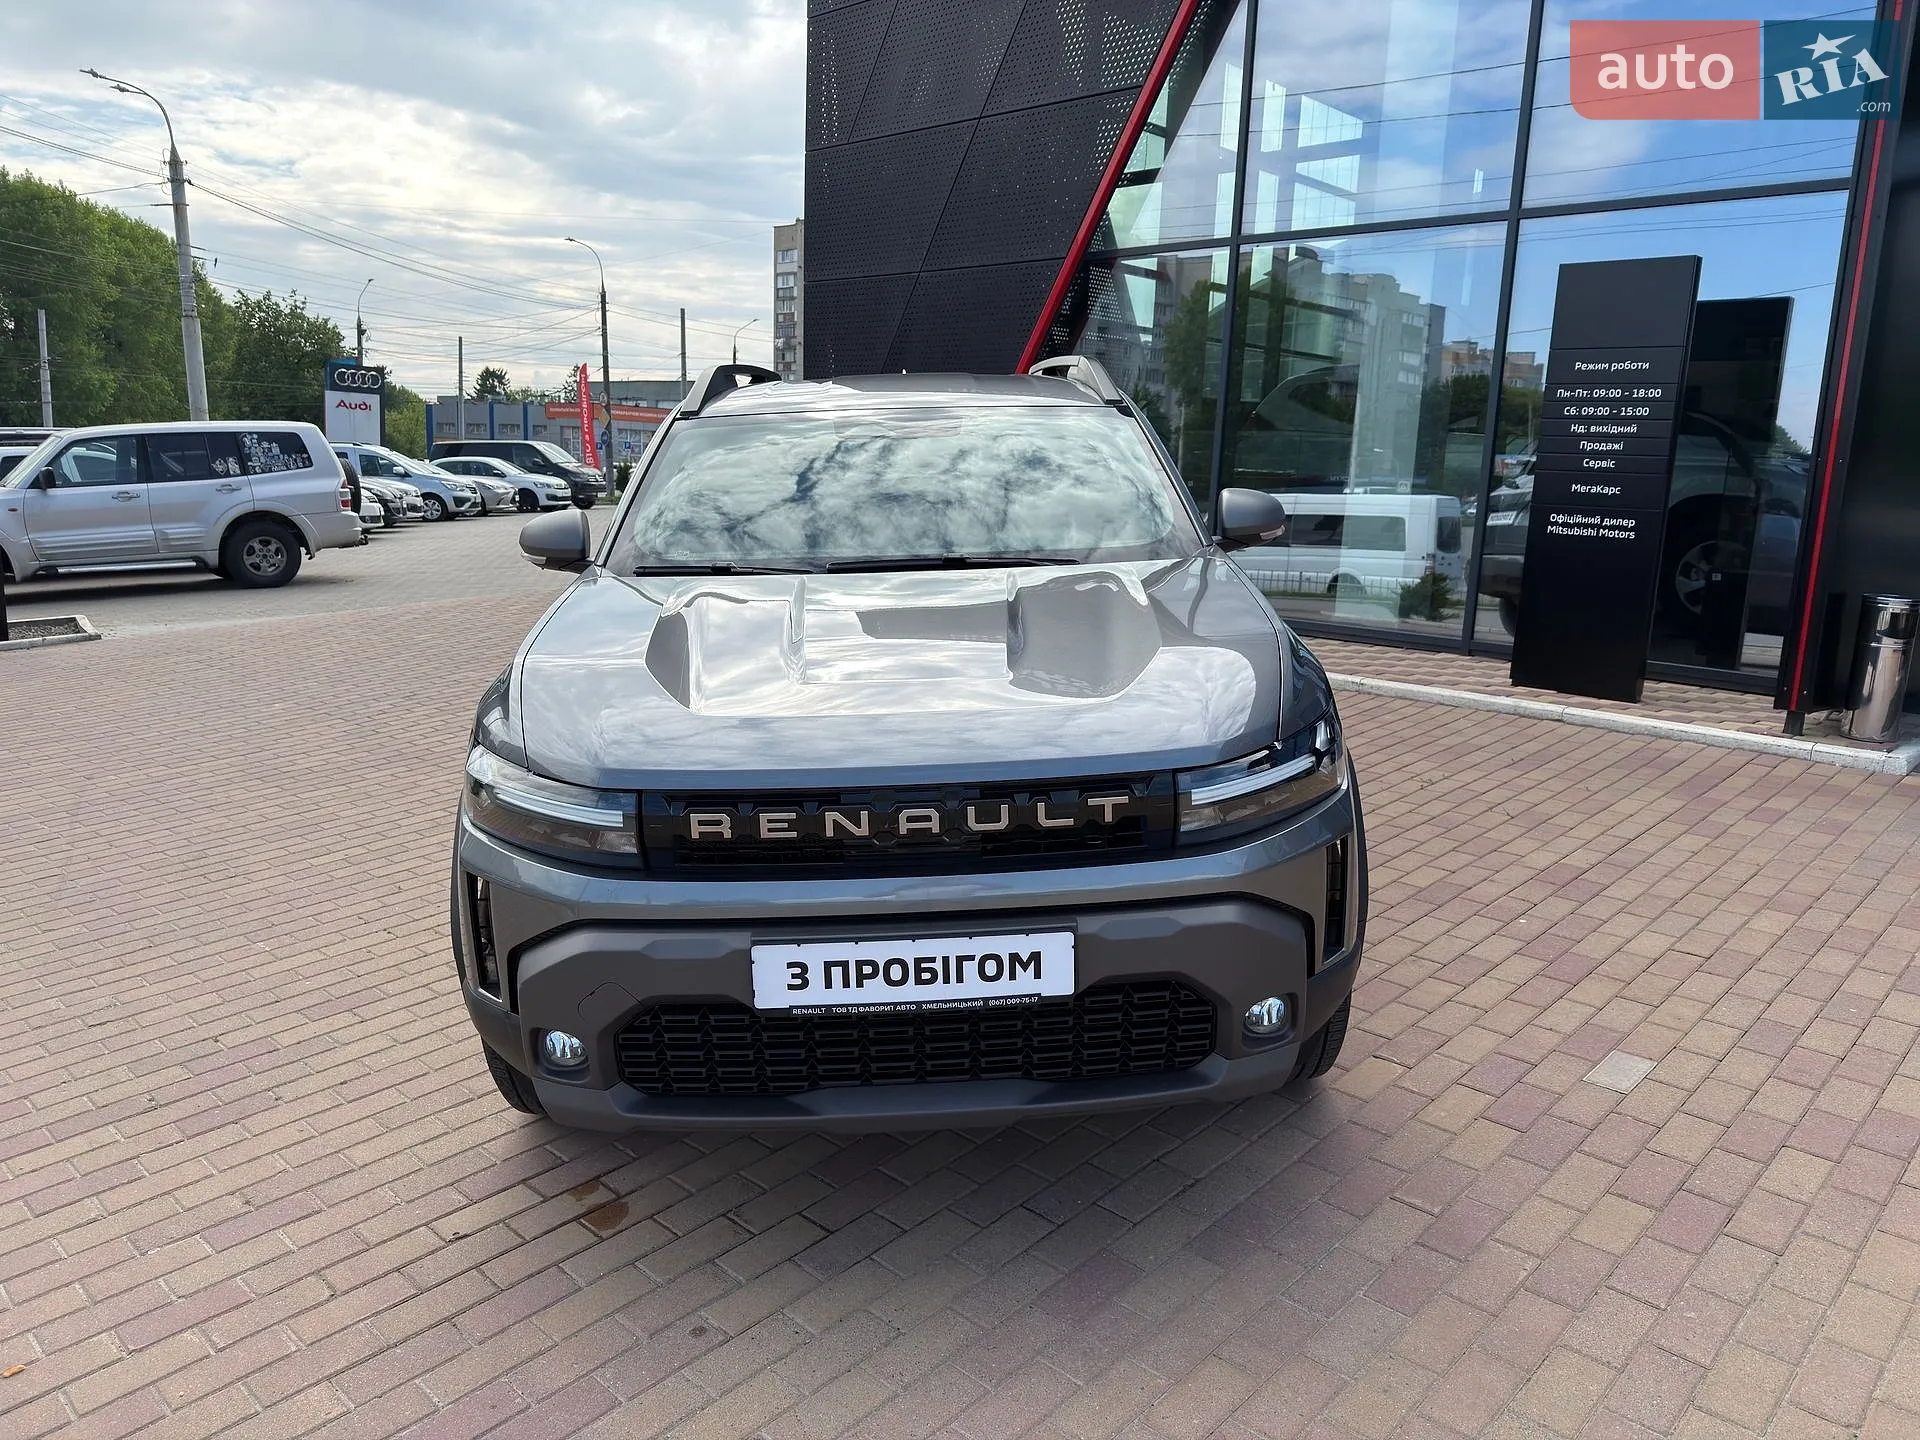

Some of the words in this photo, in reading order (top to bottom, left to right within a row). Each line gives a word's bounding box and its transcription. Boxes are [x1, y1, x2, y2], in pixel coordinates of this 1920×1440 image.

[1575, 362, 1609, 371] Режим
[1611, 360, 1649, 371] роботи
[1557, 389, 1592, 398] Пн-Пт:
[1593, 389, 1622, 398] 09:00
[1632, 389, 1662, 398] 18:00
[336, 400, 371, 410] Audi
[1564, 406, 1579, 416] Сб:
[1582, 406, 1610, 416] 09:00
[1620, 406, 1650, 416] 15:00
[1571, 424, 1588, 434] Нд:
[1590, 423, 1637, 434] вихідний
[1580, 441, 1624, 451] Продажі
[1583, 458, 1615, 469] Сервіс
[1571, 484, 1621, 495] МегаКарс
[1550, 513, 1600, 526] Офіційний
[1603, 516, 1635, 528] дилер
[1547, 525, 1597, 537] Mitsubishi
[1599, 528, 1635, 539] Motors
[689, 796, 1129, 839] RENAULT
[785, 961, 810, 991] З
[823, 951, 1042, 990] ПРОБІГОМ
[858, 1004, 894, 1013] ФАВОРИТ
[922, 999, 983, 1010] ХМЕЛЬНИЦЬКИЙ
[988, 998, 1005, 1008] (067)
[1006, 997, 1038, 1005] 009-75-17
